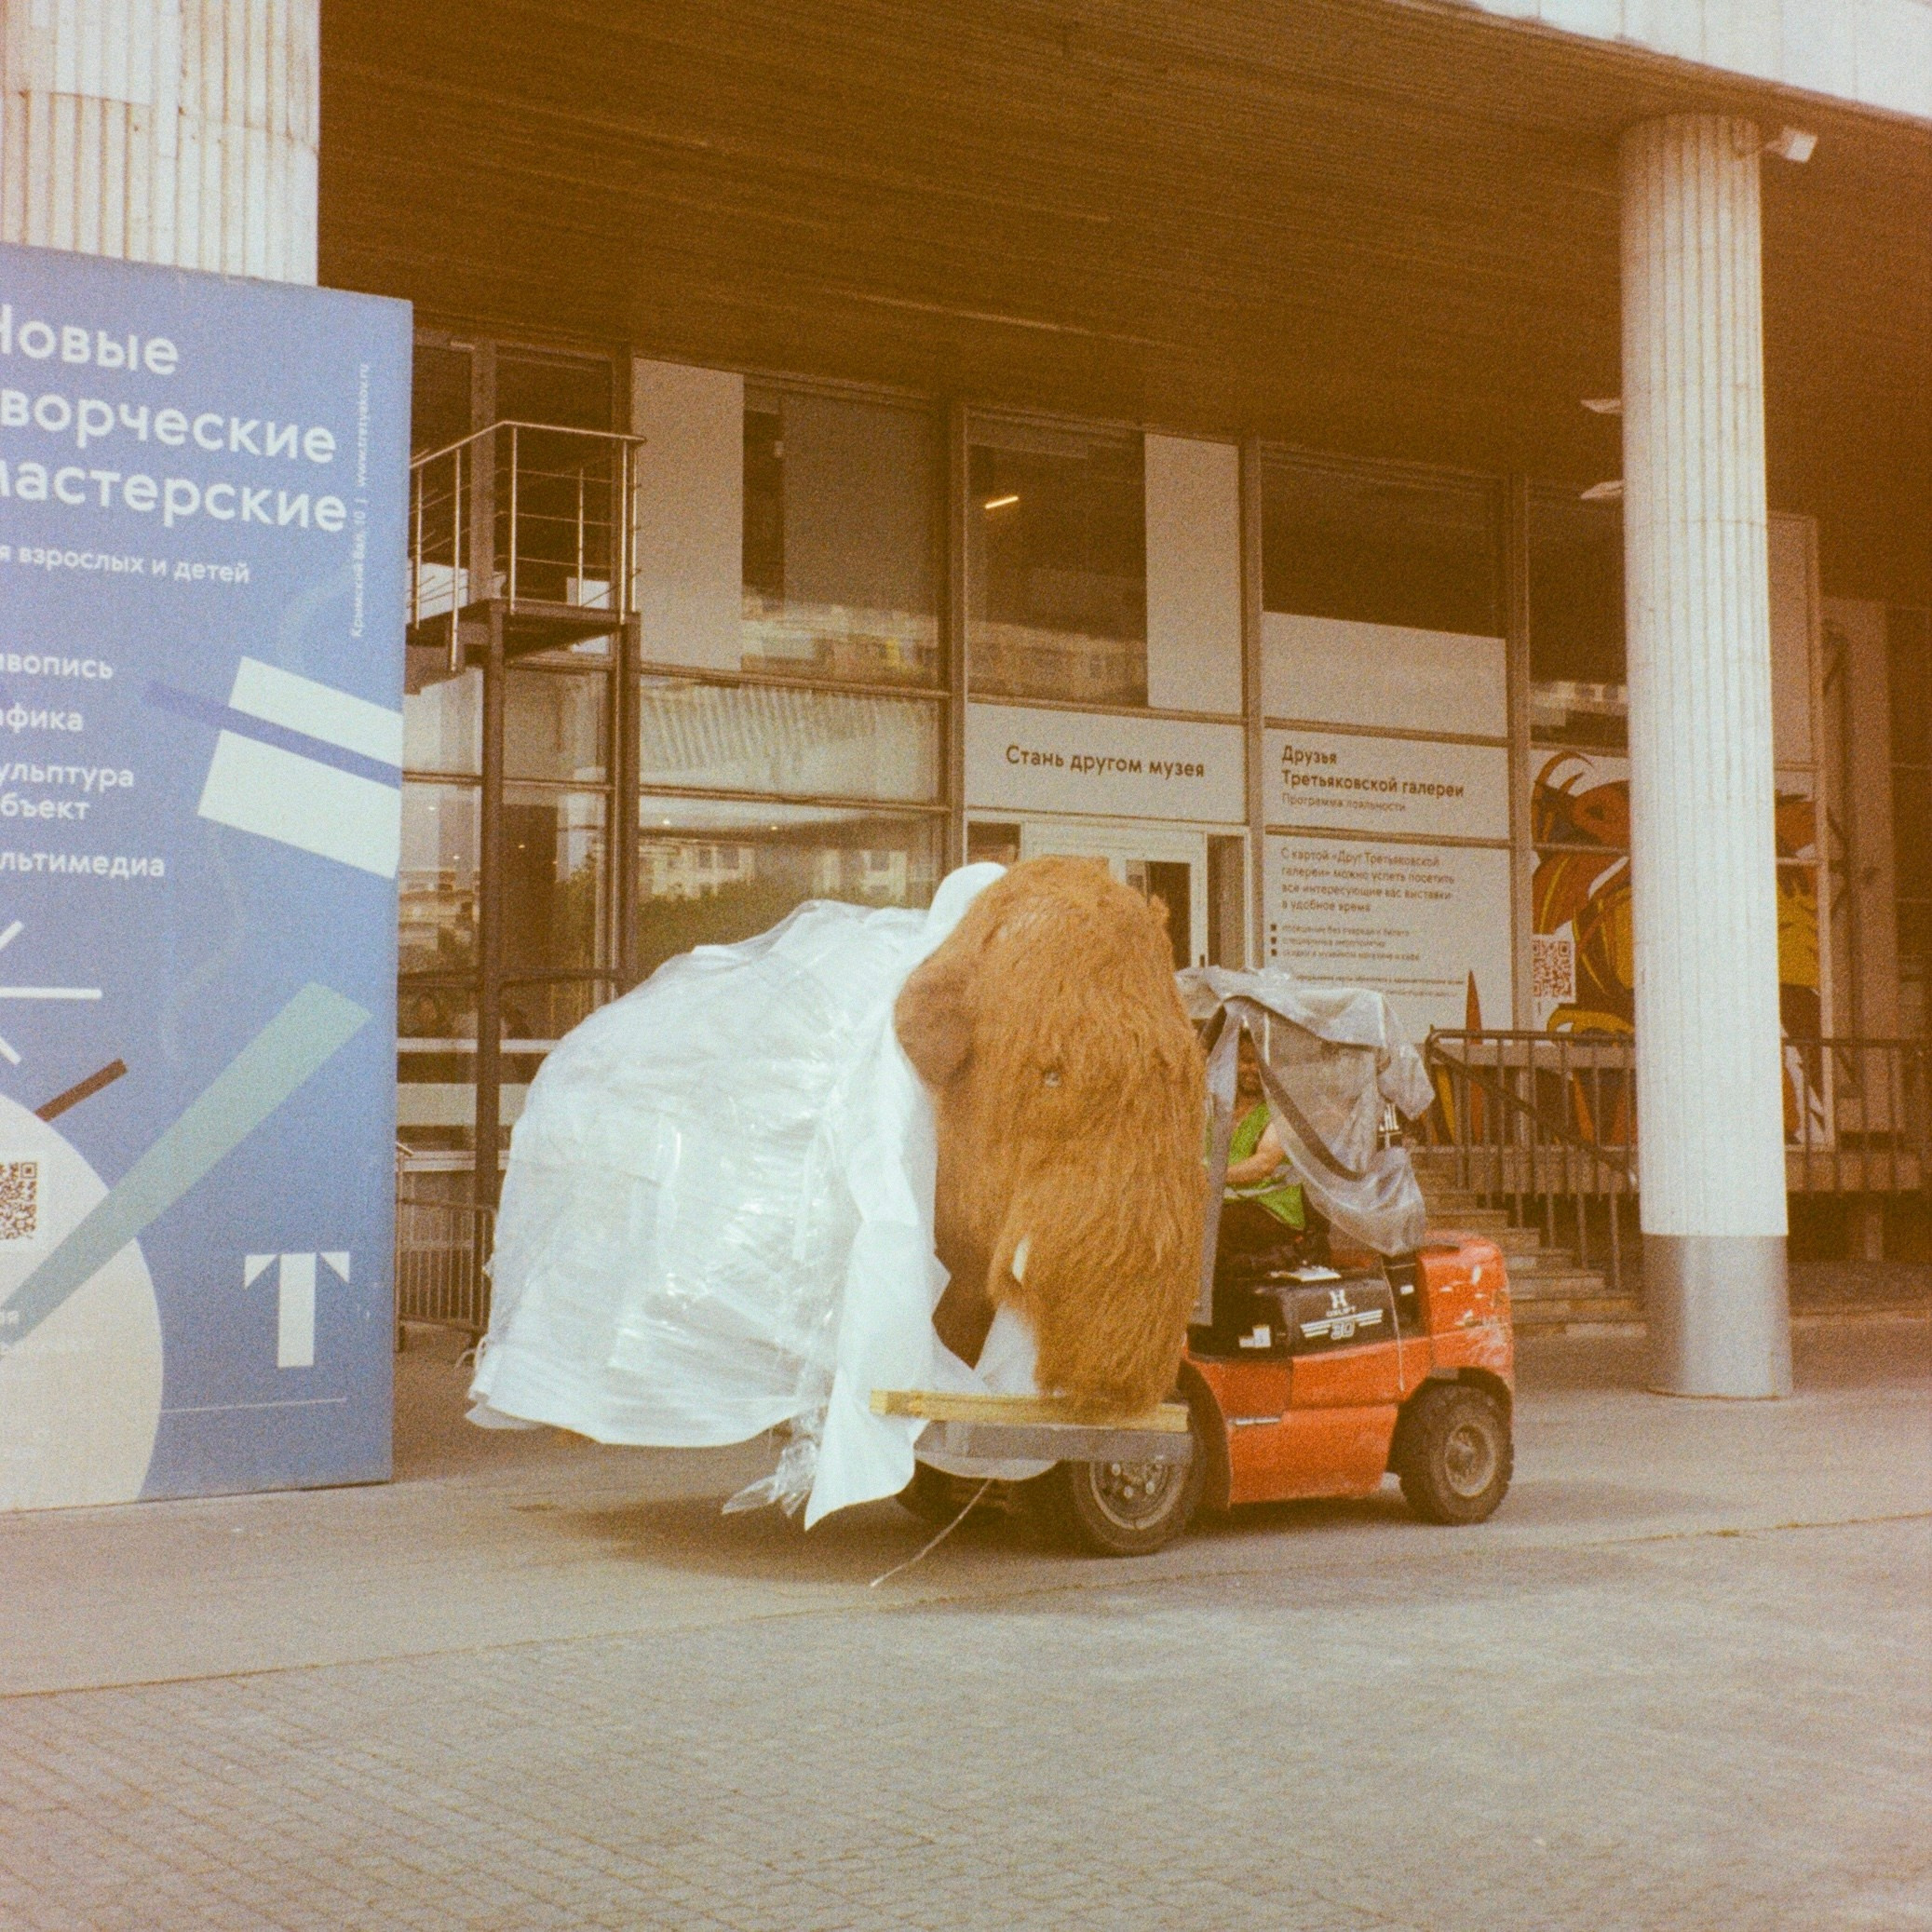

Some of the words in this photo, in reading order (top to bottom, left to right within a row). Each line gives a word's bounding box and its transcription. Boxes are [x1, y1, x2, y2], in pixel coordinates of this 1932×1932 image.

[0, 388, 337, 464] ворческие
[0, 459, 347, 533] астерские
[19, 547, 143, 572] взрослых
[152, 559, 167, 576] и
[174, 561, 250, 584] детей
[0, 653, 114, 680] вопись
[0, 702, 83, 734] фика
[1006, 744, 1064, 768] Стань
[1071, 754, 1142, 775] другом
[1149, 760, 1205, 780] музея
[1281, 745, 1337, 766] Друзья
[1281, 769, 1398, 792] Третьяковской
[1402, 780, 1465, 799] галереи
[1280, 847, 1290, 859] С
